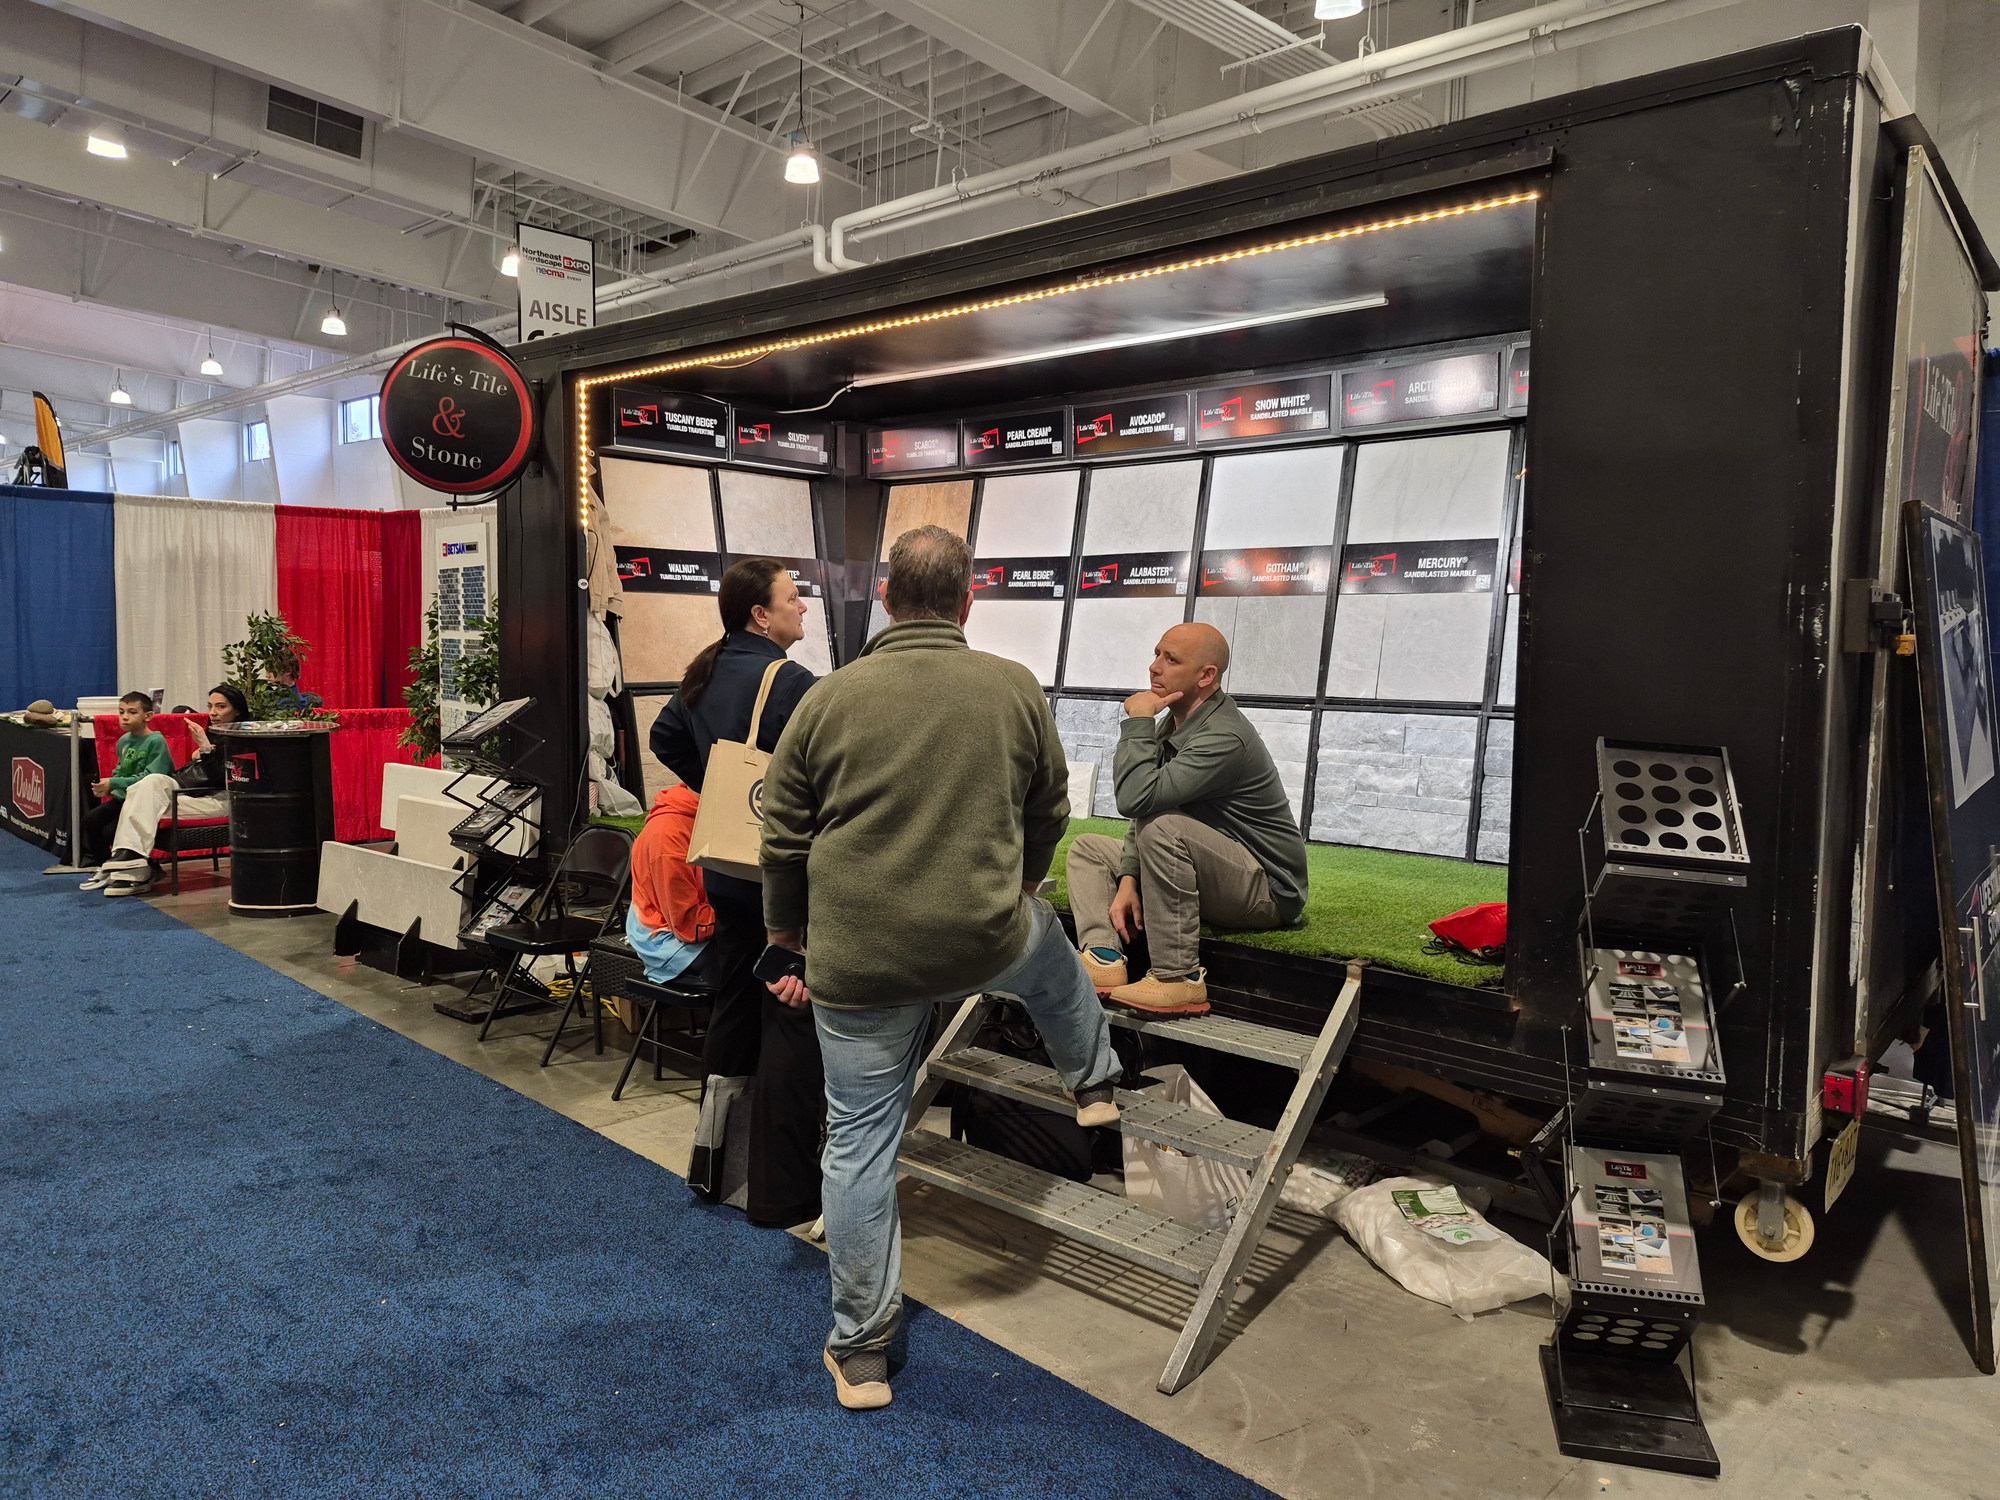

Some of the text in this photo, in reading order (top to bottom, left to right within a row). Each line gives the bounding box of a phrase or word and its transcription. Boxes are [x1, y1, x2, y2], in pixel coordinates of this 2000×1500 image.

[522, 246, 562, 261] Northeast
[564, 257, 590, 273] EXPO
[536, 266, 565, 279] necma
[528, 299, 587, 327] AISLE
[407, 360, 508, 396] Life's Tile
[1255, 398, 1279, 412] SNOW
[432, 396, 466, 439] &
[664, 412, 695, 426] TUSCANY
[1250, 406, 1313, 421] SANDBLASTED MARBLE
[666, 423, 715, 437] TUMBLED TRAVERTINE
[1006, 429, 1026, 441] PEARL
[1119, 423, 1174, 437] SANDBLASTED MARBLE
[777, 440, 819, 453] TUMBLED TRAVERTINE
[1005, 437, 1053, 449] SANDBLASTED MARBLE
[411, 436, 482, 470] Stone
[1417, 556, 1469, 569] MERCURY®
[659, 573, 709, 582] TUMBLED TRAVERTINE
[1012, 570, 1032, 580] PEARL
[1129, 566, 1174, 578] ALABASTER®
[1403, 570, 1477, 579] SANDBLASTED MARBLE
[1123, 577, 1177, 586] SANDBLASTED MARBLE
[231, 774, 250, 783] Stone
